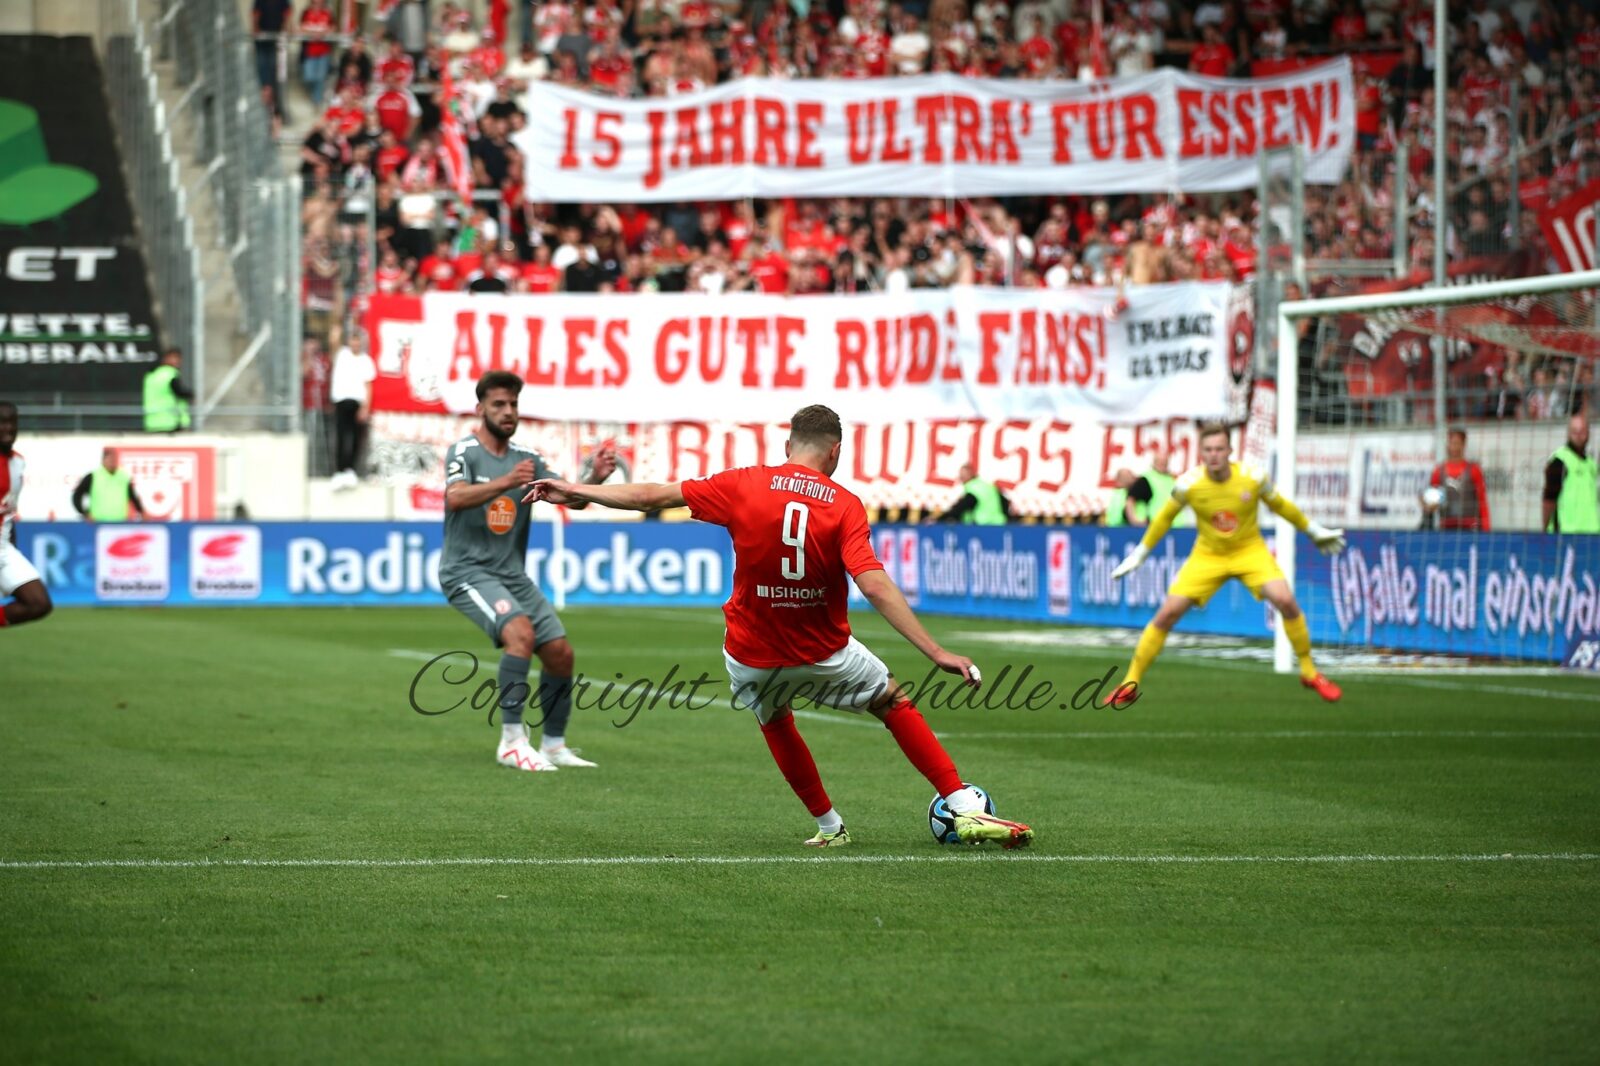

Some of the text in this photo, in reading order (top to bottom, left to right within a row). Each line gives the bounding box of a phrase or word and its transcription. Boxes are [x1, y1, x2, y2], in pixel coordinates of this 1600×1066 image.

[558, 107, 624, 170] 15
[642, 96, 825, 189] JAHRE
[1050, 83, 1165, 165] FÜR
[1175, 78, 1341, 158] ESSEN!
[0, 247, 118, 281] ET
[447, 309, 631, 389] ALLES
[653, 314, 808, 389] GUTE
[976, 309, 1107, 389] FANS!
[287, 530, 445, 594] Radio
[524, 532, 722, 596] rocken
[781, 501, 810, 580] 9
[1425, 544, 1479, 632] mal
